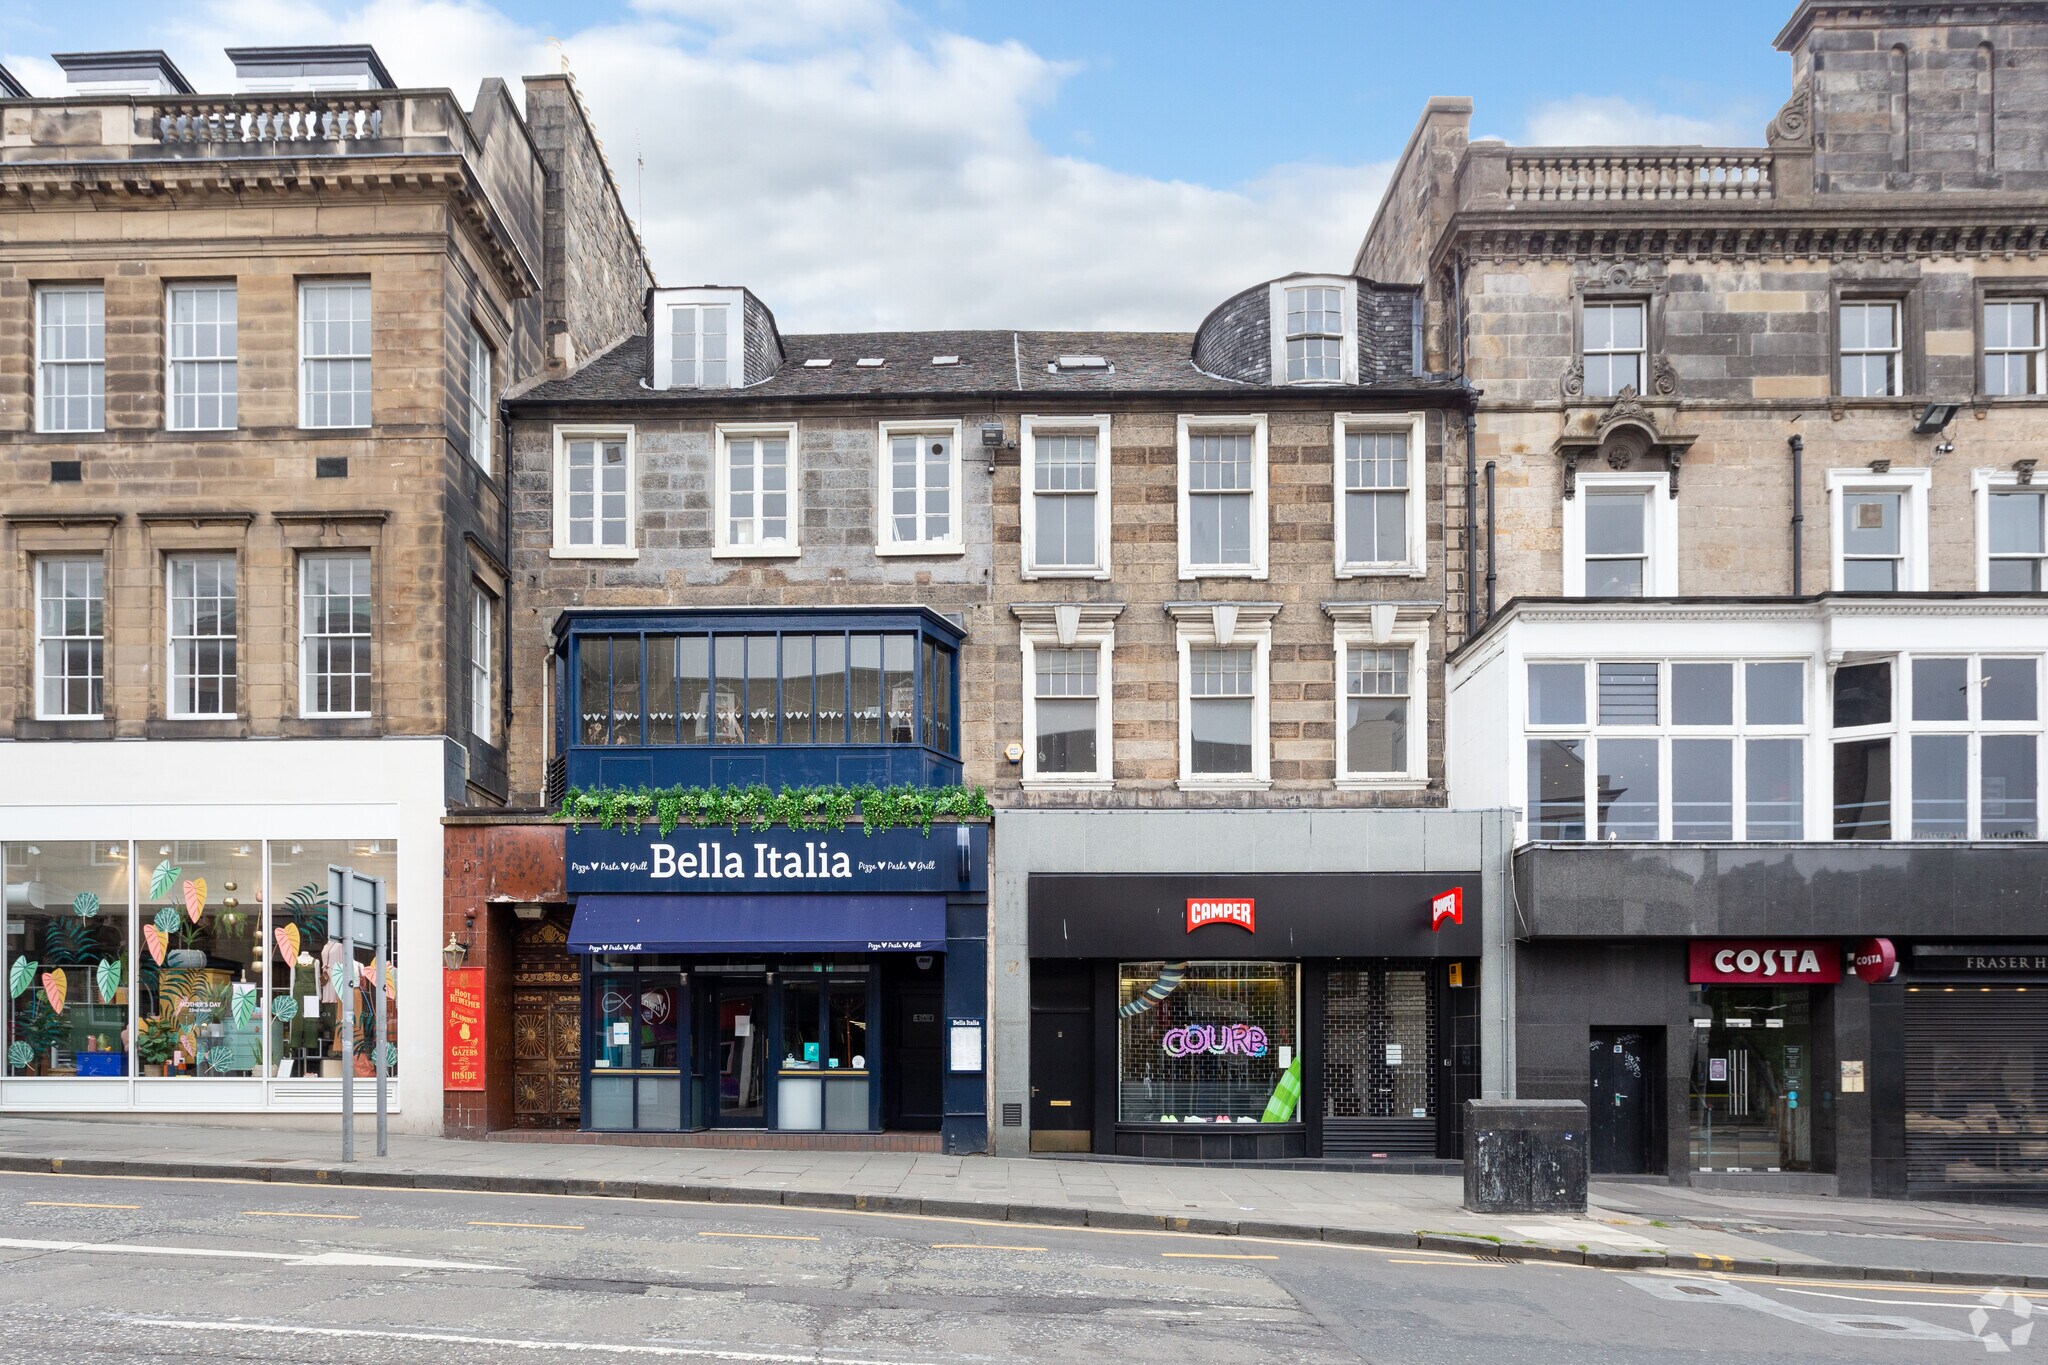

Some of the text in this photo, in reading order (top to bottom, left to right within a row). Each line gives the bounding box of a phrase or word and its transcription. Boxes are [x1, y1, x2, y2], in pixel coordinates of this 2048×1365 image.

[572, 861, 648, 874] Pizza Pasta Grill
[650, 841, 853, 879] Bella Italia
[858, 860, 936, 874] Pizza Pasta Grill
[1191, 902, 1251, 925] CAMPER
[1433, 893, 1456, 922] CAMPER
[1714, 949, 1821, 977] COSTA
[1856, 953, 1882, 966] COSTA
[1966, 957, 2048, 969] FRASER H
[1162, 1023, 1269, 1058] COURB
[451, 1071, 477, 1080] INSIDE
